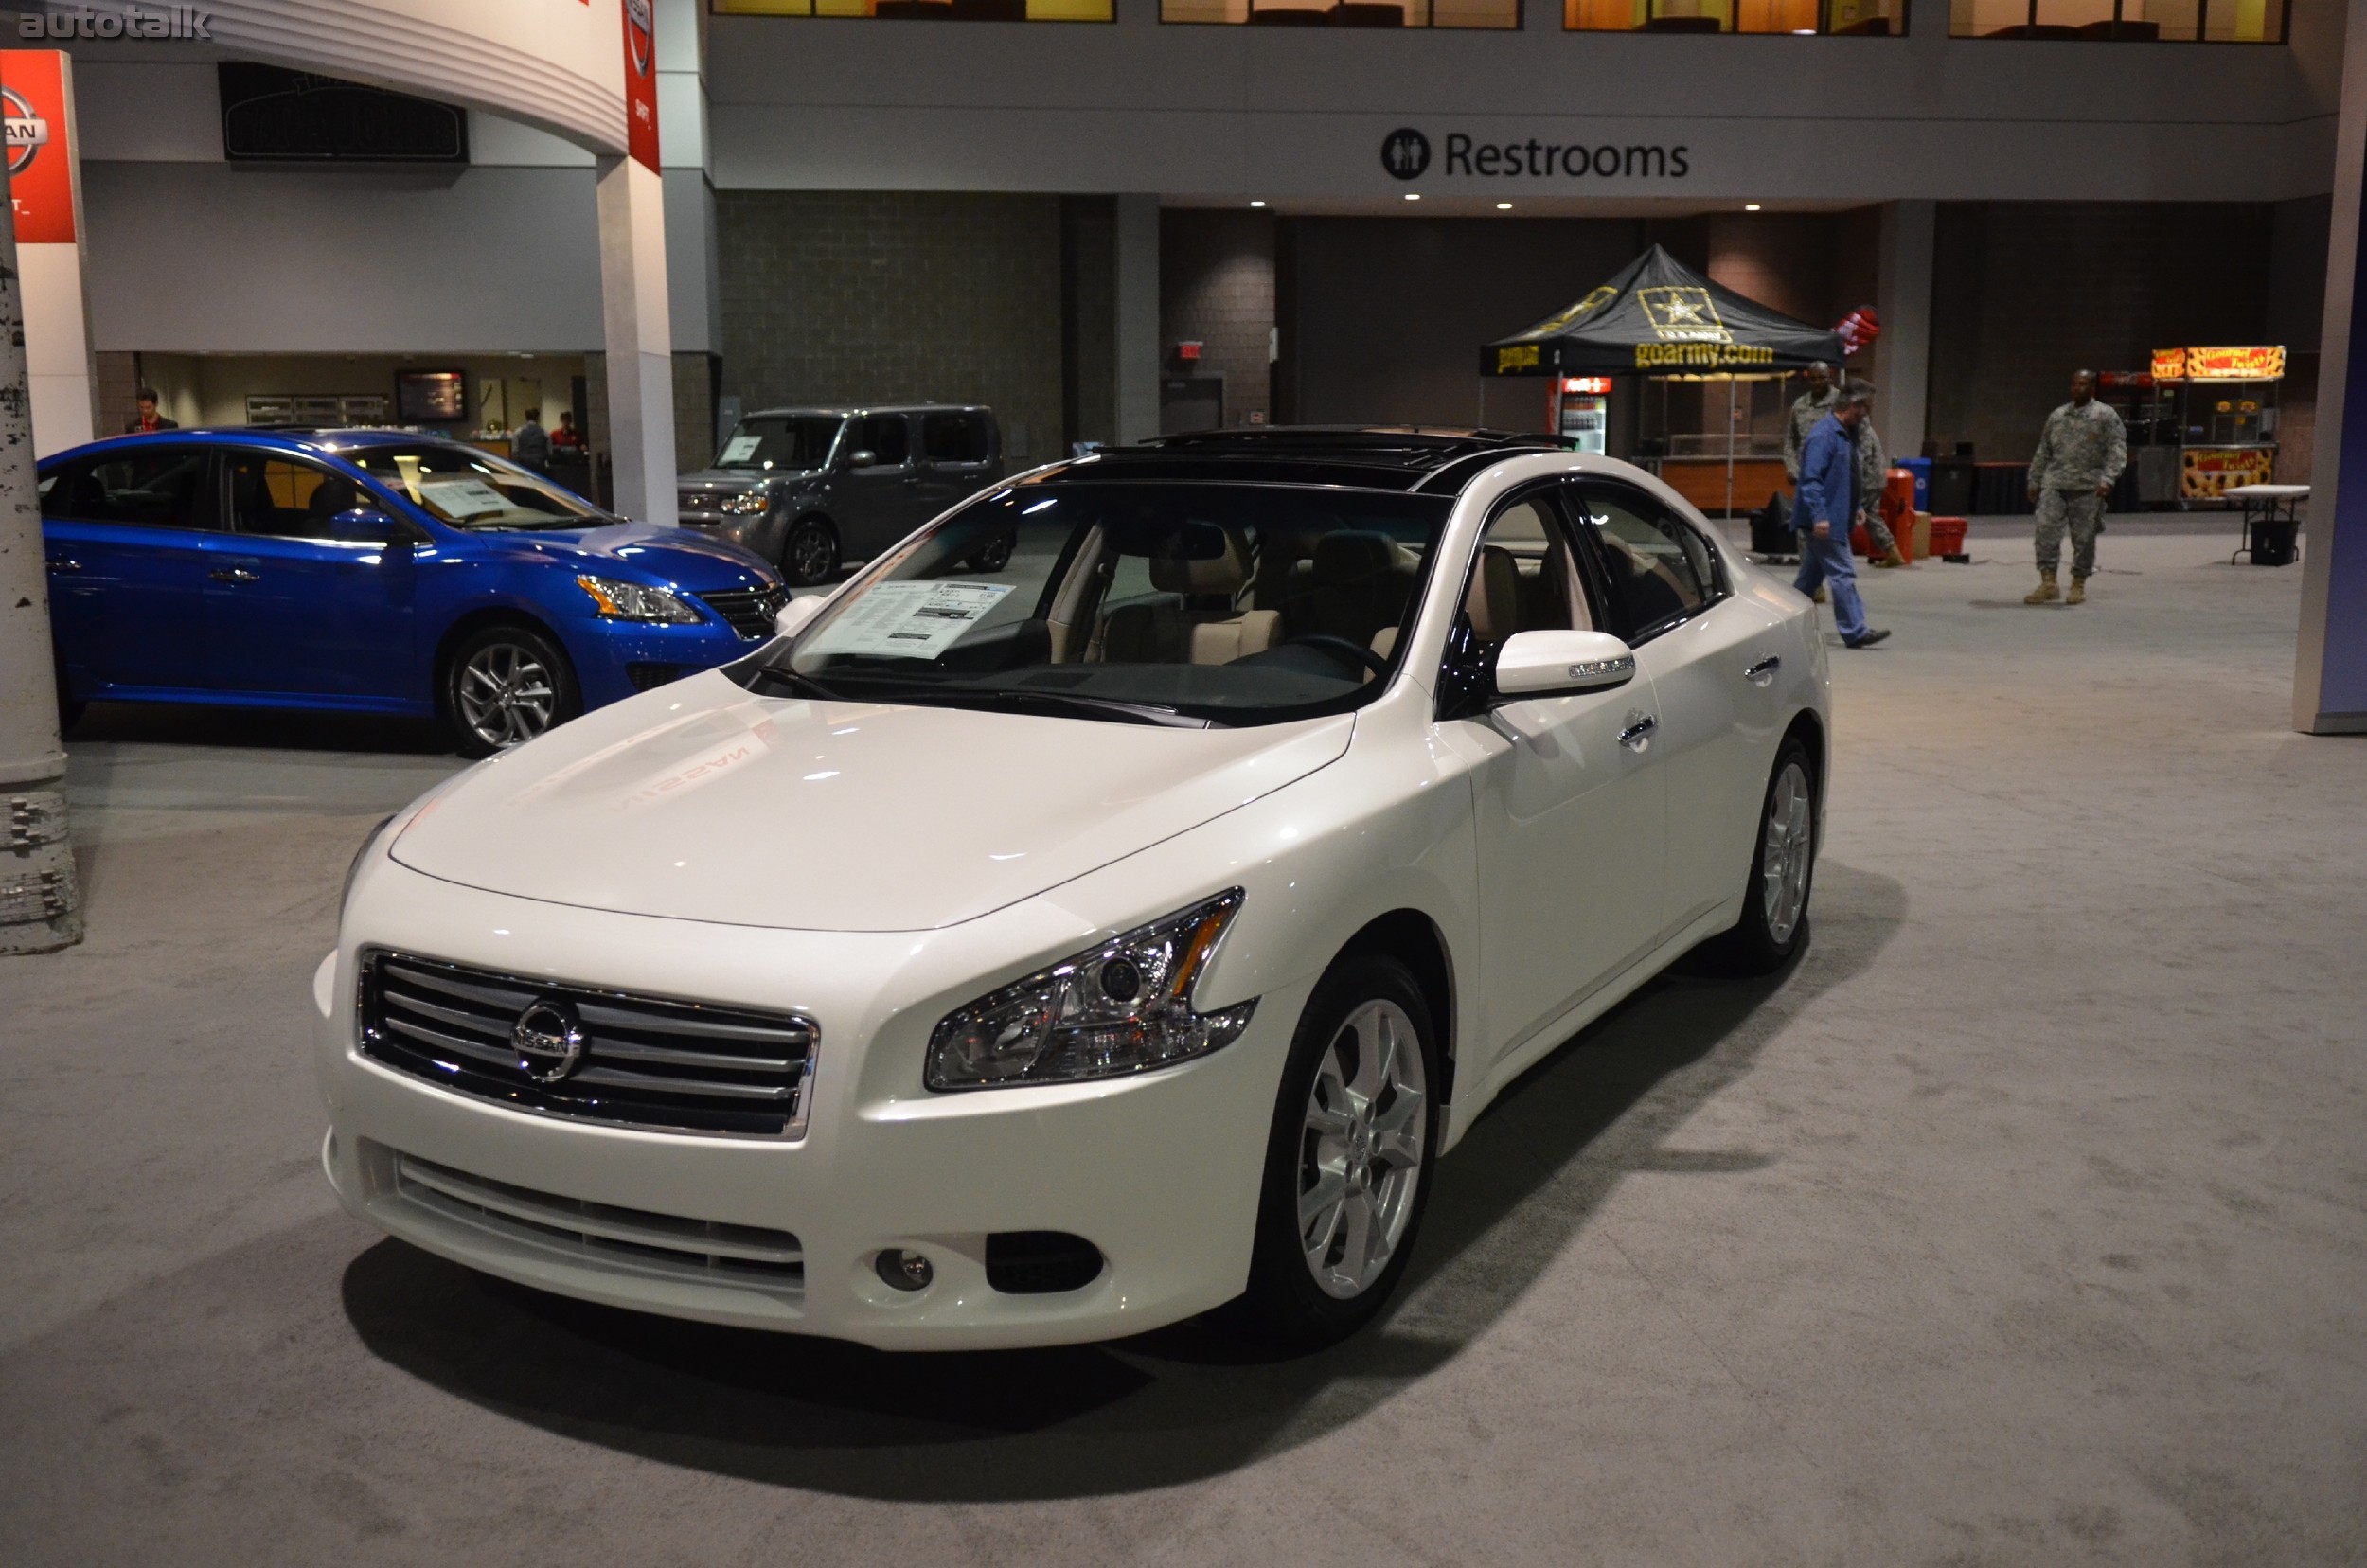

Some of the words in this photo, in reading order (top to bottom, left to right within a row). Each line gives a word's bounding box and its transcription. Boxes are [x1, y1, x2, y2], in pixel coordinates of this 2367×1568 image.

[1445, 133, 1689, 177] Restrooms
[1635, 343, 1773, 368] goarmy.com
[2207, 347, 2251, 360] Gourmet
[512, 1028, 568, 1054] NISSAN
